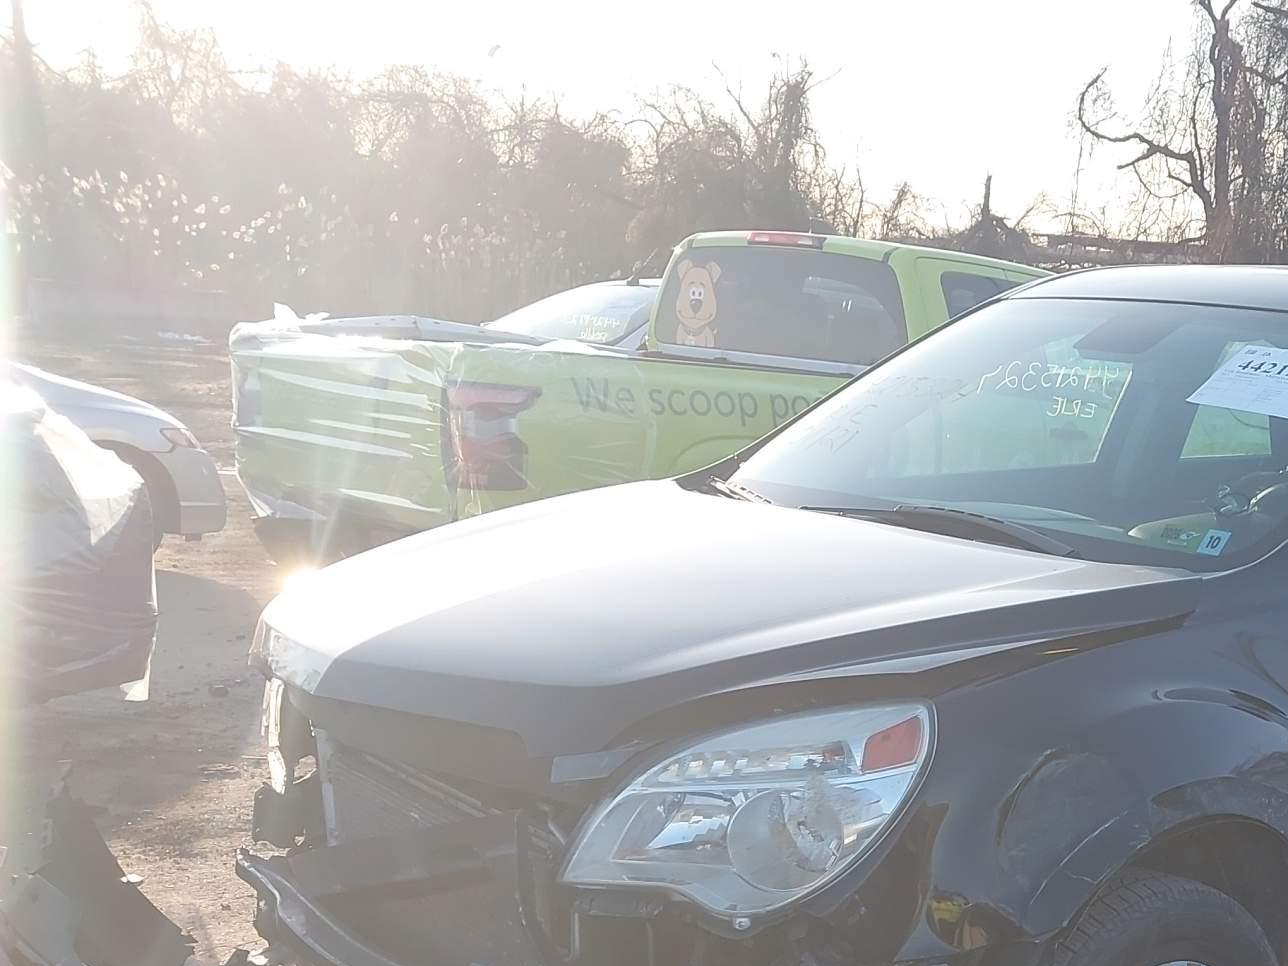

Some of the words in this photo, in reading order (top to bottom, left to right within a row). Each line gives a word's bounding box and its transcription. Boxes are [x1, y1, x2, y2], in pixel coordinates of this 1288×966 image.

[569, 376, 635, 417] We
[648, 388, 758, 426] scoop
[1205, 535, 1222, 550] 10
